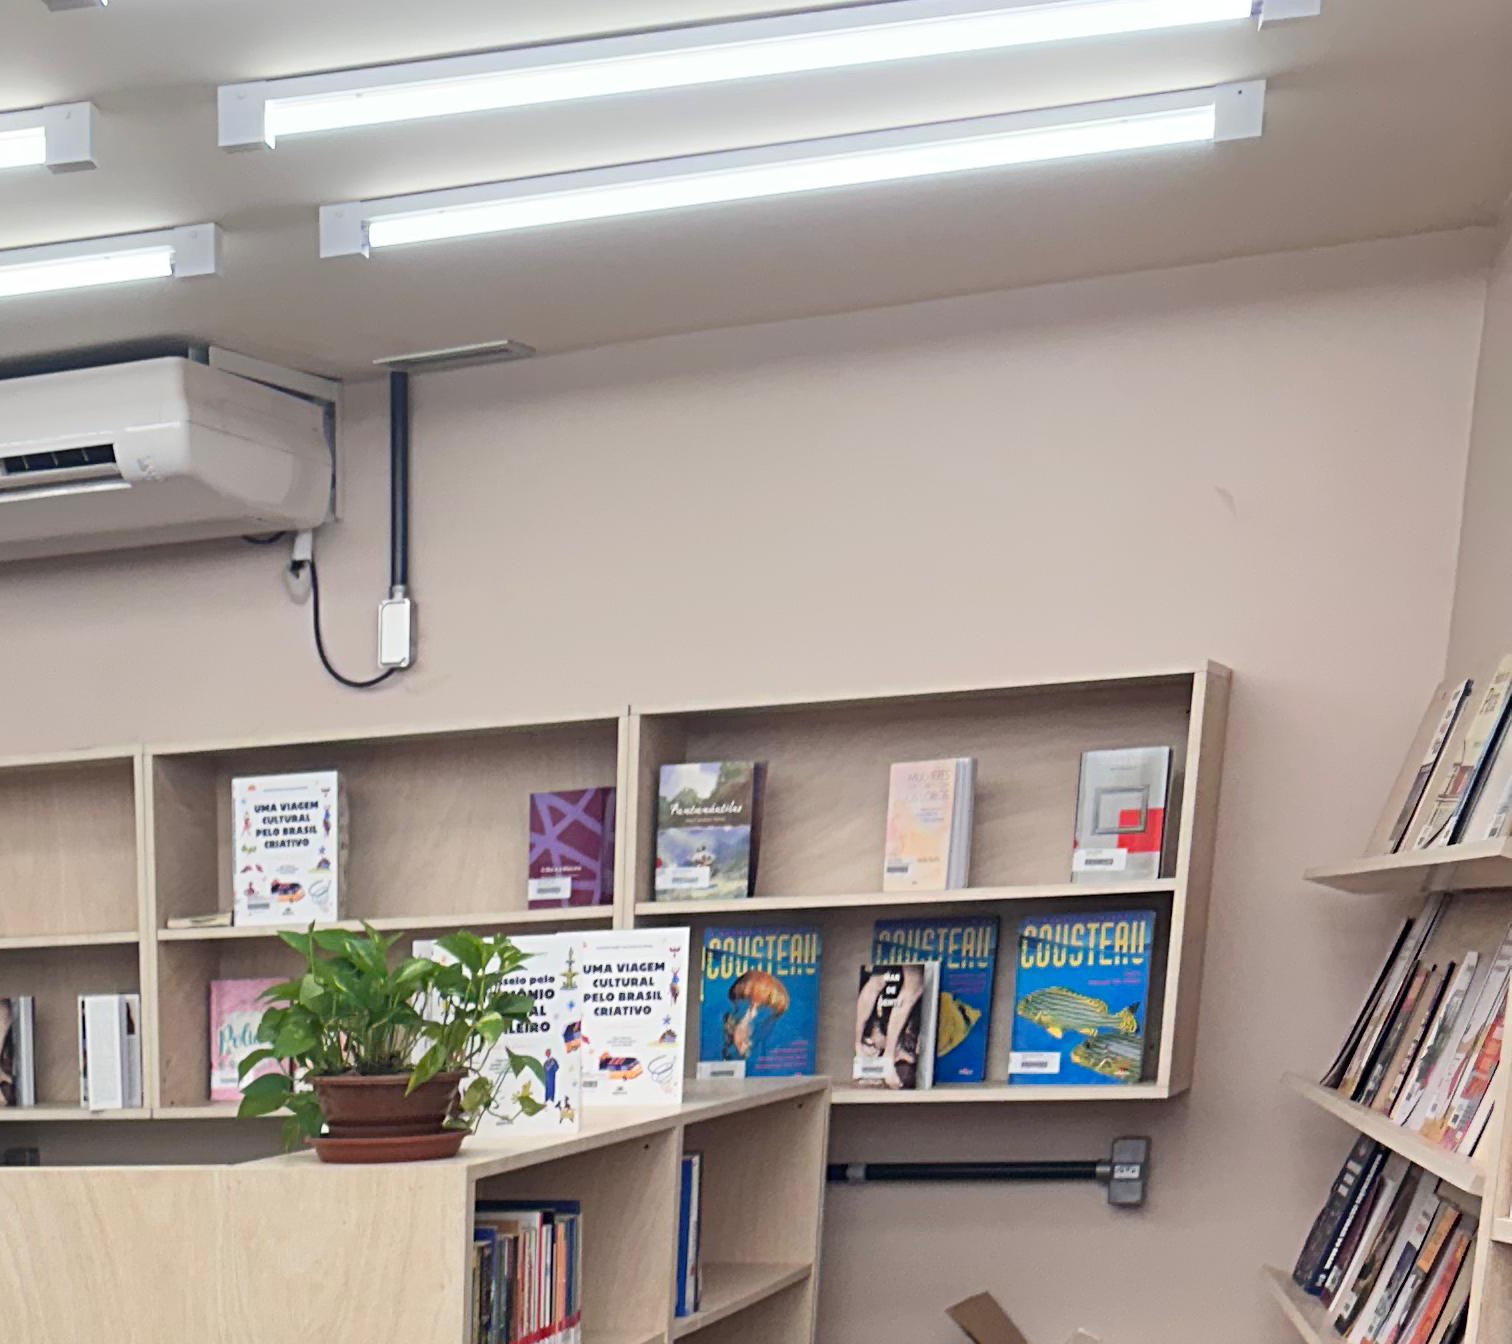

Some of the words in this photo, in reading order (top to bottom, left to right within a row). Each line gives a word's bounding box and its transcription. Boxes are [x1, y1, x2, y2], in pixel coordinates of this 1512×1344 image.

[254, 804, 277, 813] UMA
[280, 801, 319, 811] VIAGEM
[262, 815, 310, 825] CULTURAL
[255, 828, 280, 837] PELO
[282, 826, 317, 836] BRASIL
[264, 839, 310, 849] CRIATIVO
[874, 927, 993, 970] COUSTEAU
[1020, 921, 1146, 969] COUSTEAU
[706, 934, 817, 980] COUSTEAU
[583, 964, 613, 974] UMA
[617, 962, 666, 973] VIAGEM
[529, 975, 556, 985] pelo
[593, 977, 655, 988] CULTURAL
[584, 993, 614, 1003] PELO
[619, 991, 663, 1002] BRASIL
[594, 1006, 652, 1016] CRIATIVO
[504, 1021, 551, 1035] ILEIRO
